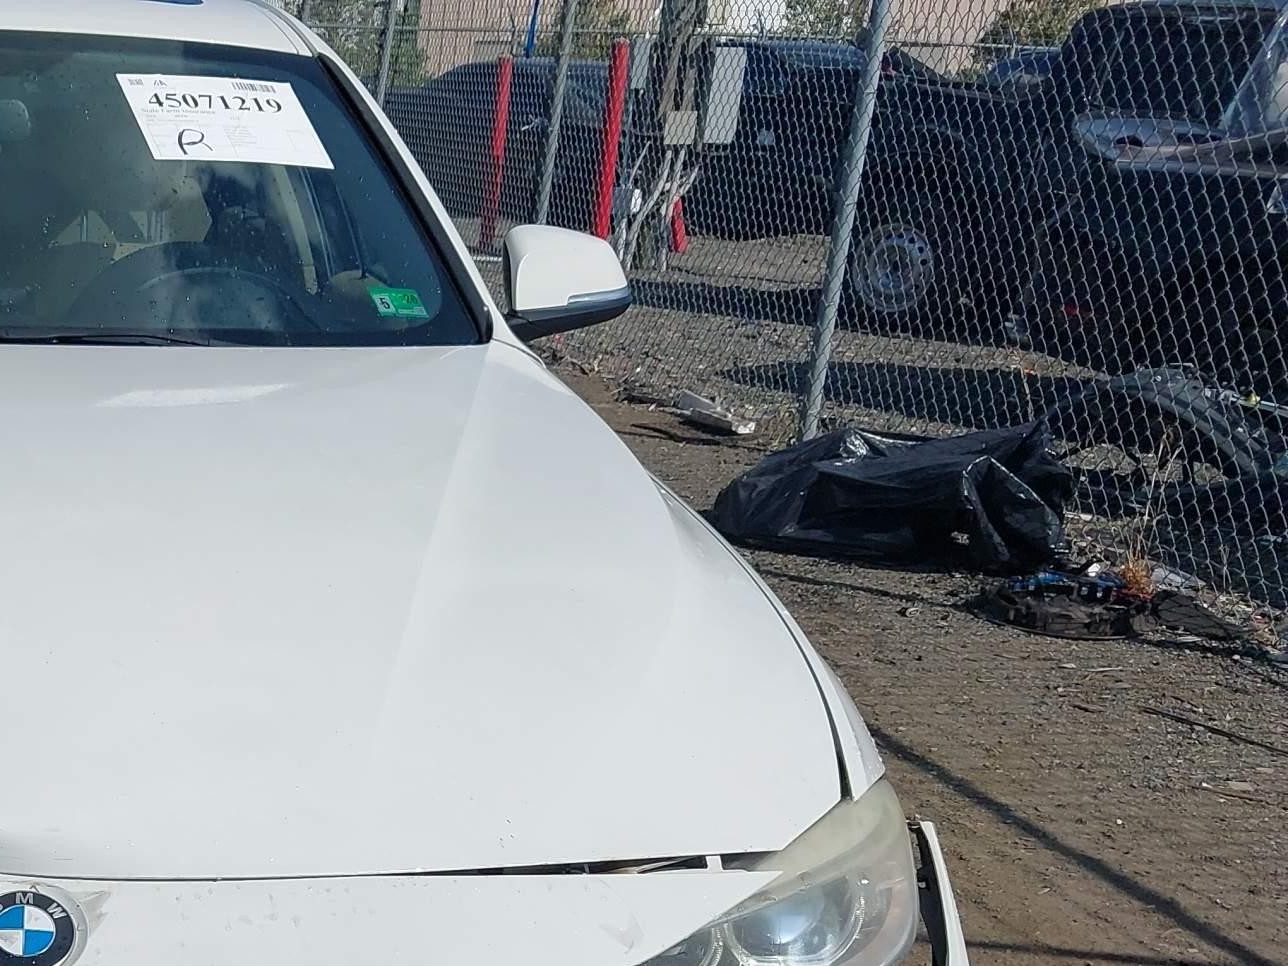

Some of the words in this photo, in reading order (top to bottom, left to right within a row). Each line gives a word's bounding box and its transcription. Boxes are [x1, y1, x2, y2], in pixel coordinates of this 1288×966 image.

[148, 92, 282, 114] 45071219
[177, 128, 214, 155] R
[379, 297, 391, 310] 5
